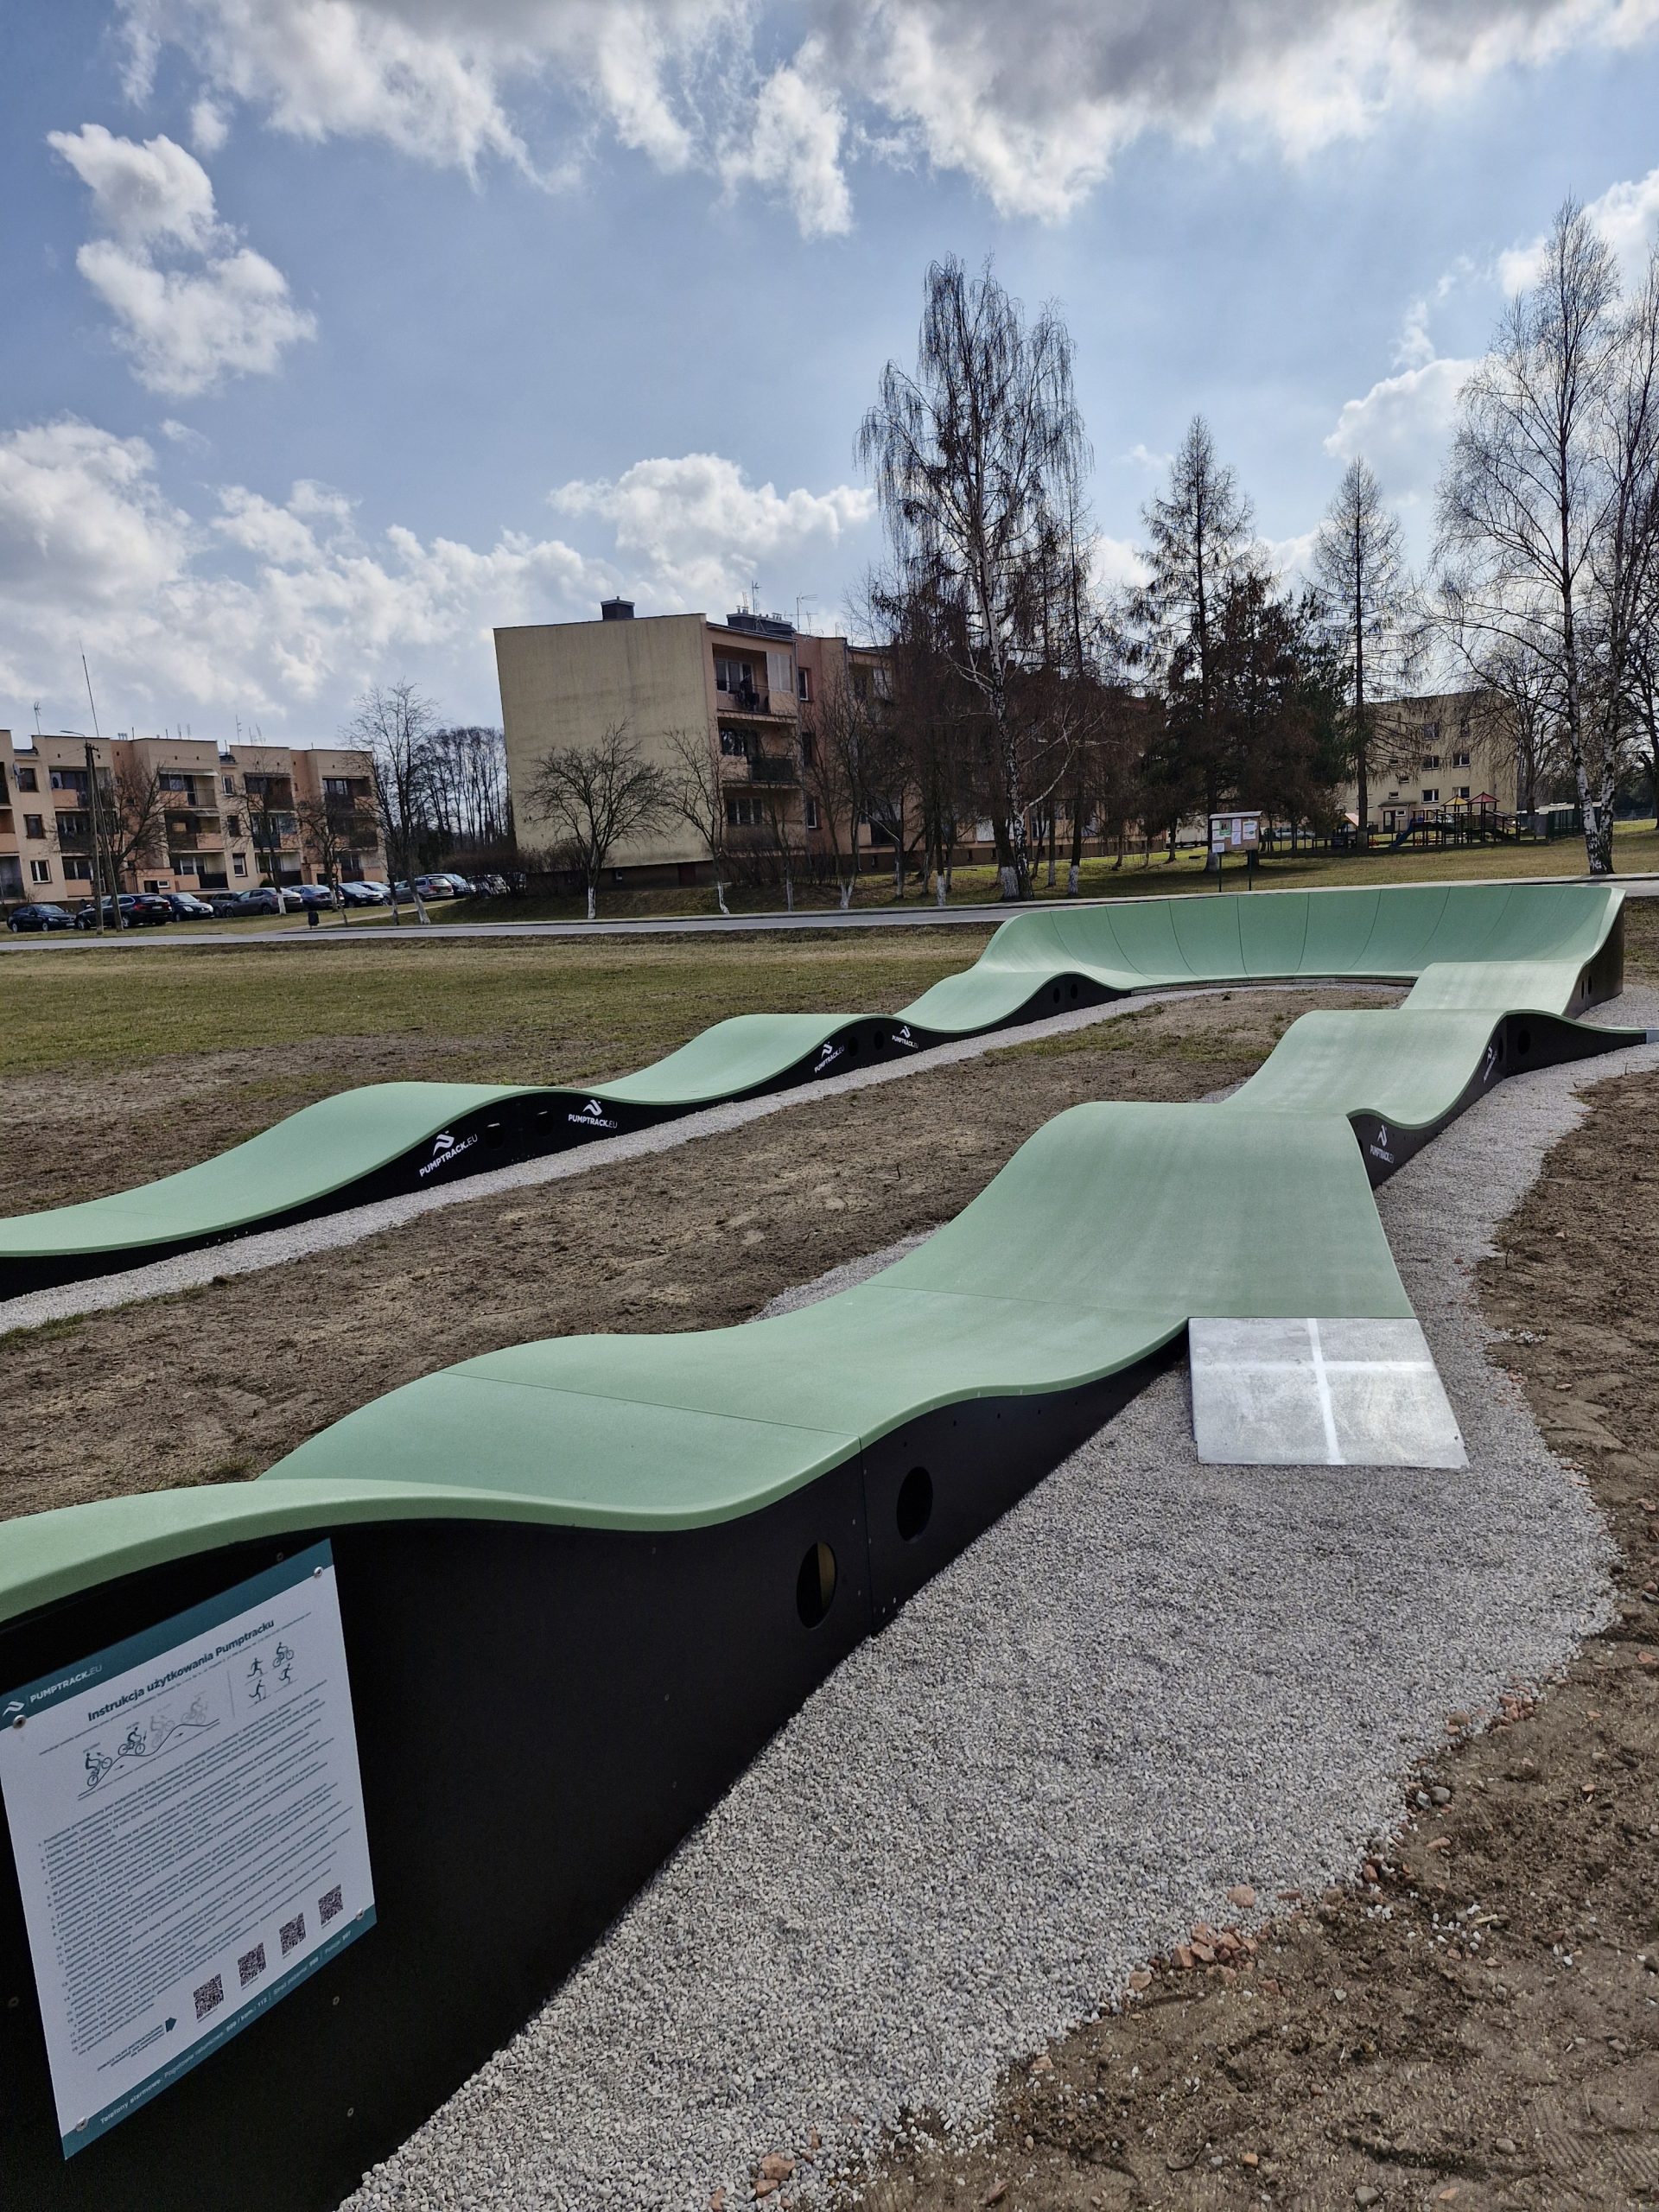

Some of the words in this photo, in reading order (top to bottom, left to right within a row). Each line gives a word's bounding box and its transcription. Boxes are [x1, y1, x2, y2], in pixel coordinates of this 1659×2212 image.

[568, 1114, 618, 1128] PUMPTRACK.EU
[419, 1134, 479, 1178] PUMPTRACK.EU
[29, 1665, 102, 1703] PUMPTRACK.EU
[87, 1688, 145, 1722] Instrukcja
[147, 1651, 213, 1692] użytkowania
[215, 1619, 275, 1657] Pumptracku
